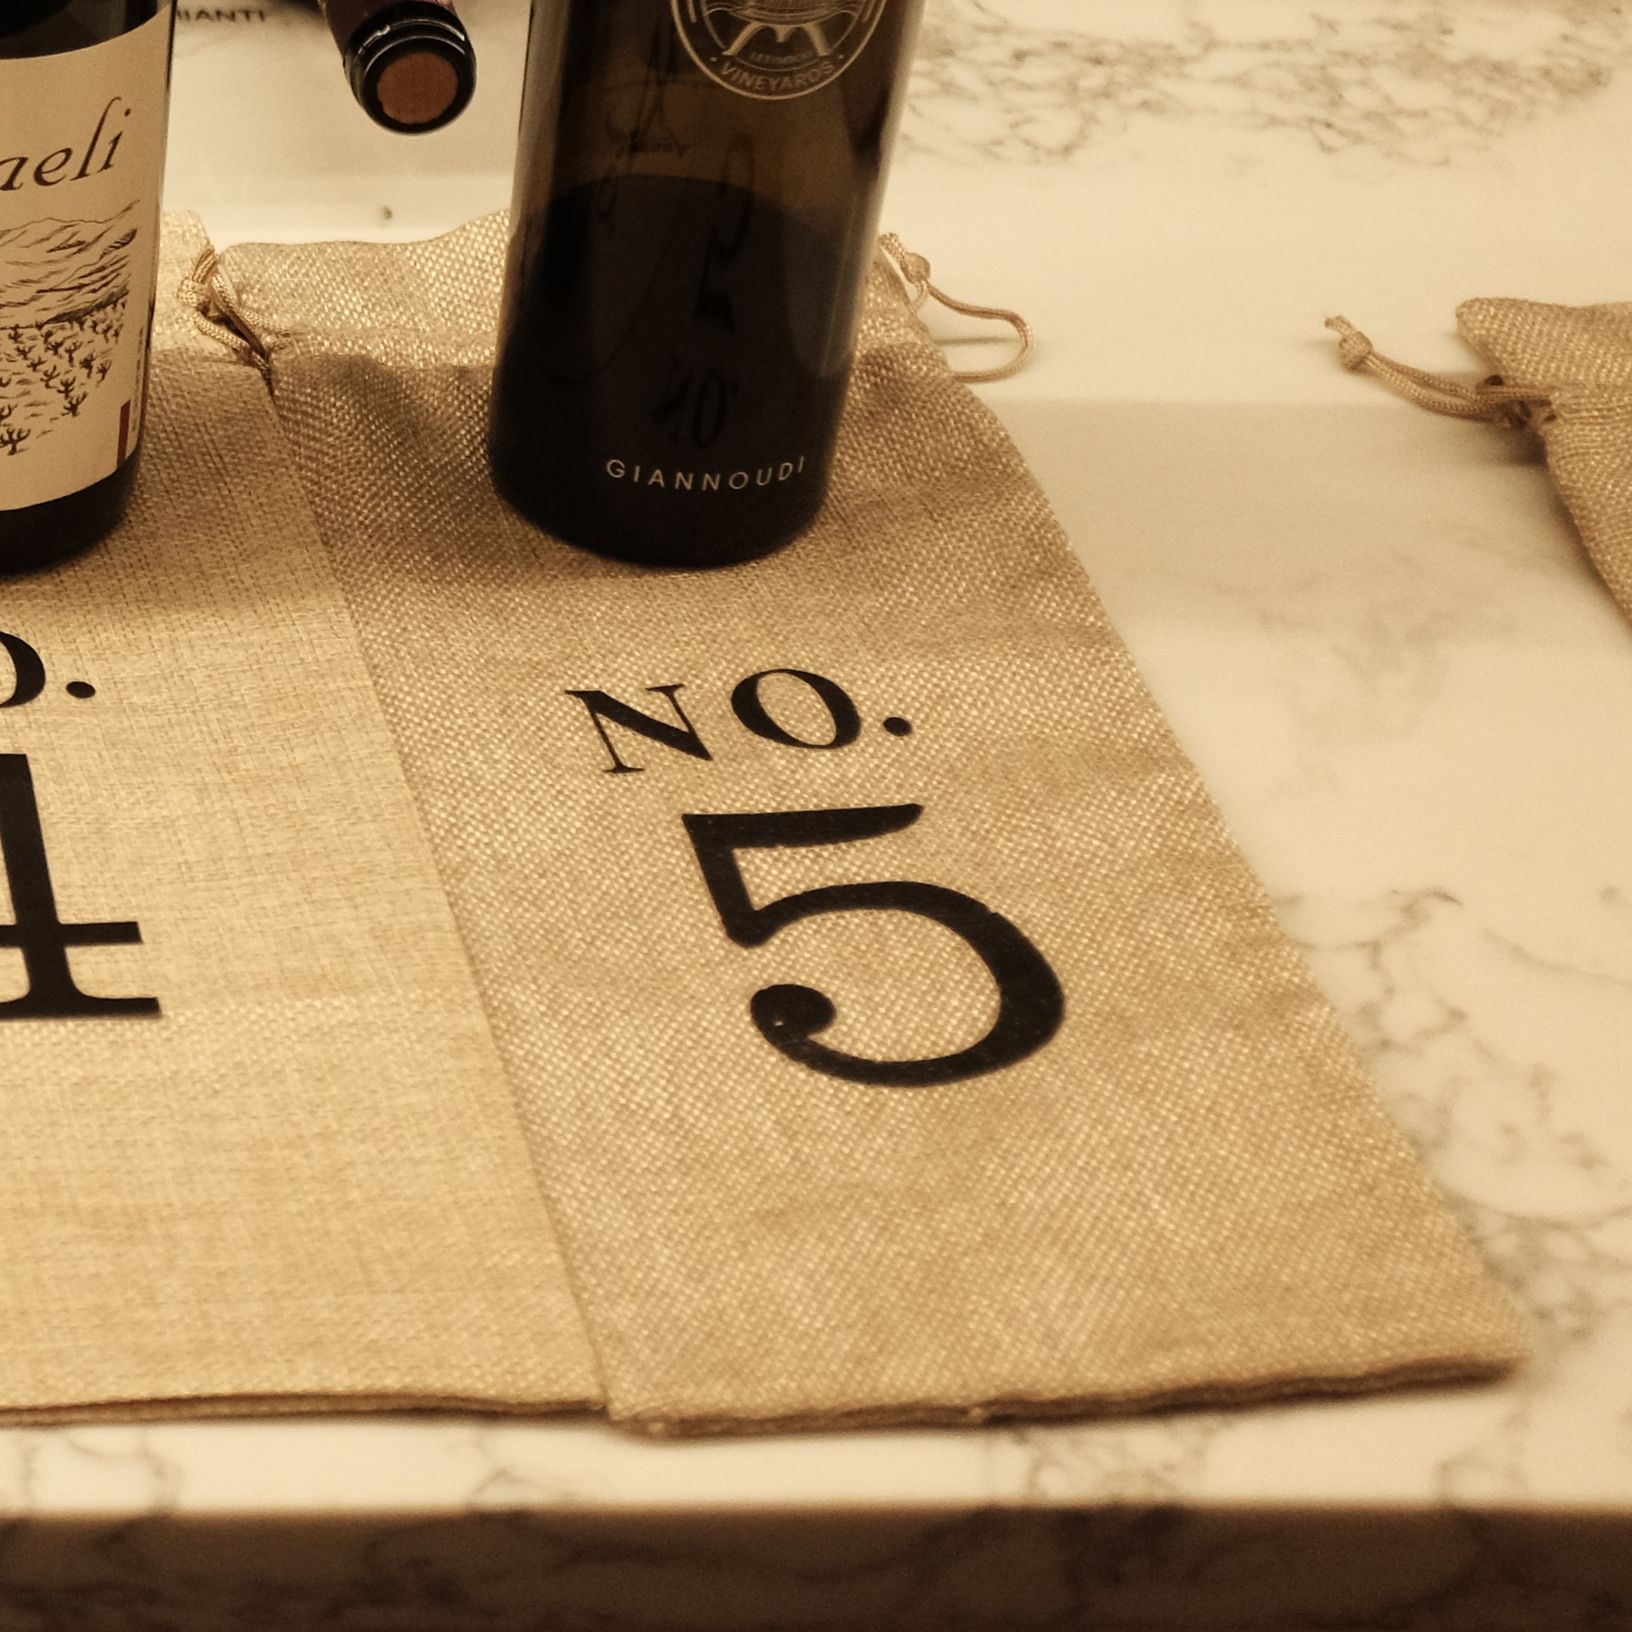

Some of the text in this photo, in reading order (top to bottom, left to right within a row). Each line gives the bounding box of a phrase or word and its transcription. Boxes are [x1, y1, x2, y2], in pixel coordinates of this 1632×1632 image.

[177, 8, 267, 25] IANTI
[719, 60, 836, 92] VINEYARDS
[605, 453, 808, 491] GIANNOUDI
[564, 668, 913, 774] NO.
[681, 803, 1065, 1088] 5
